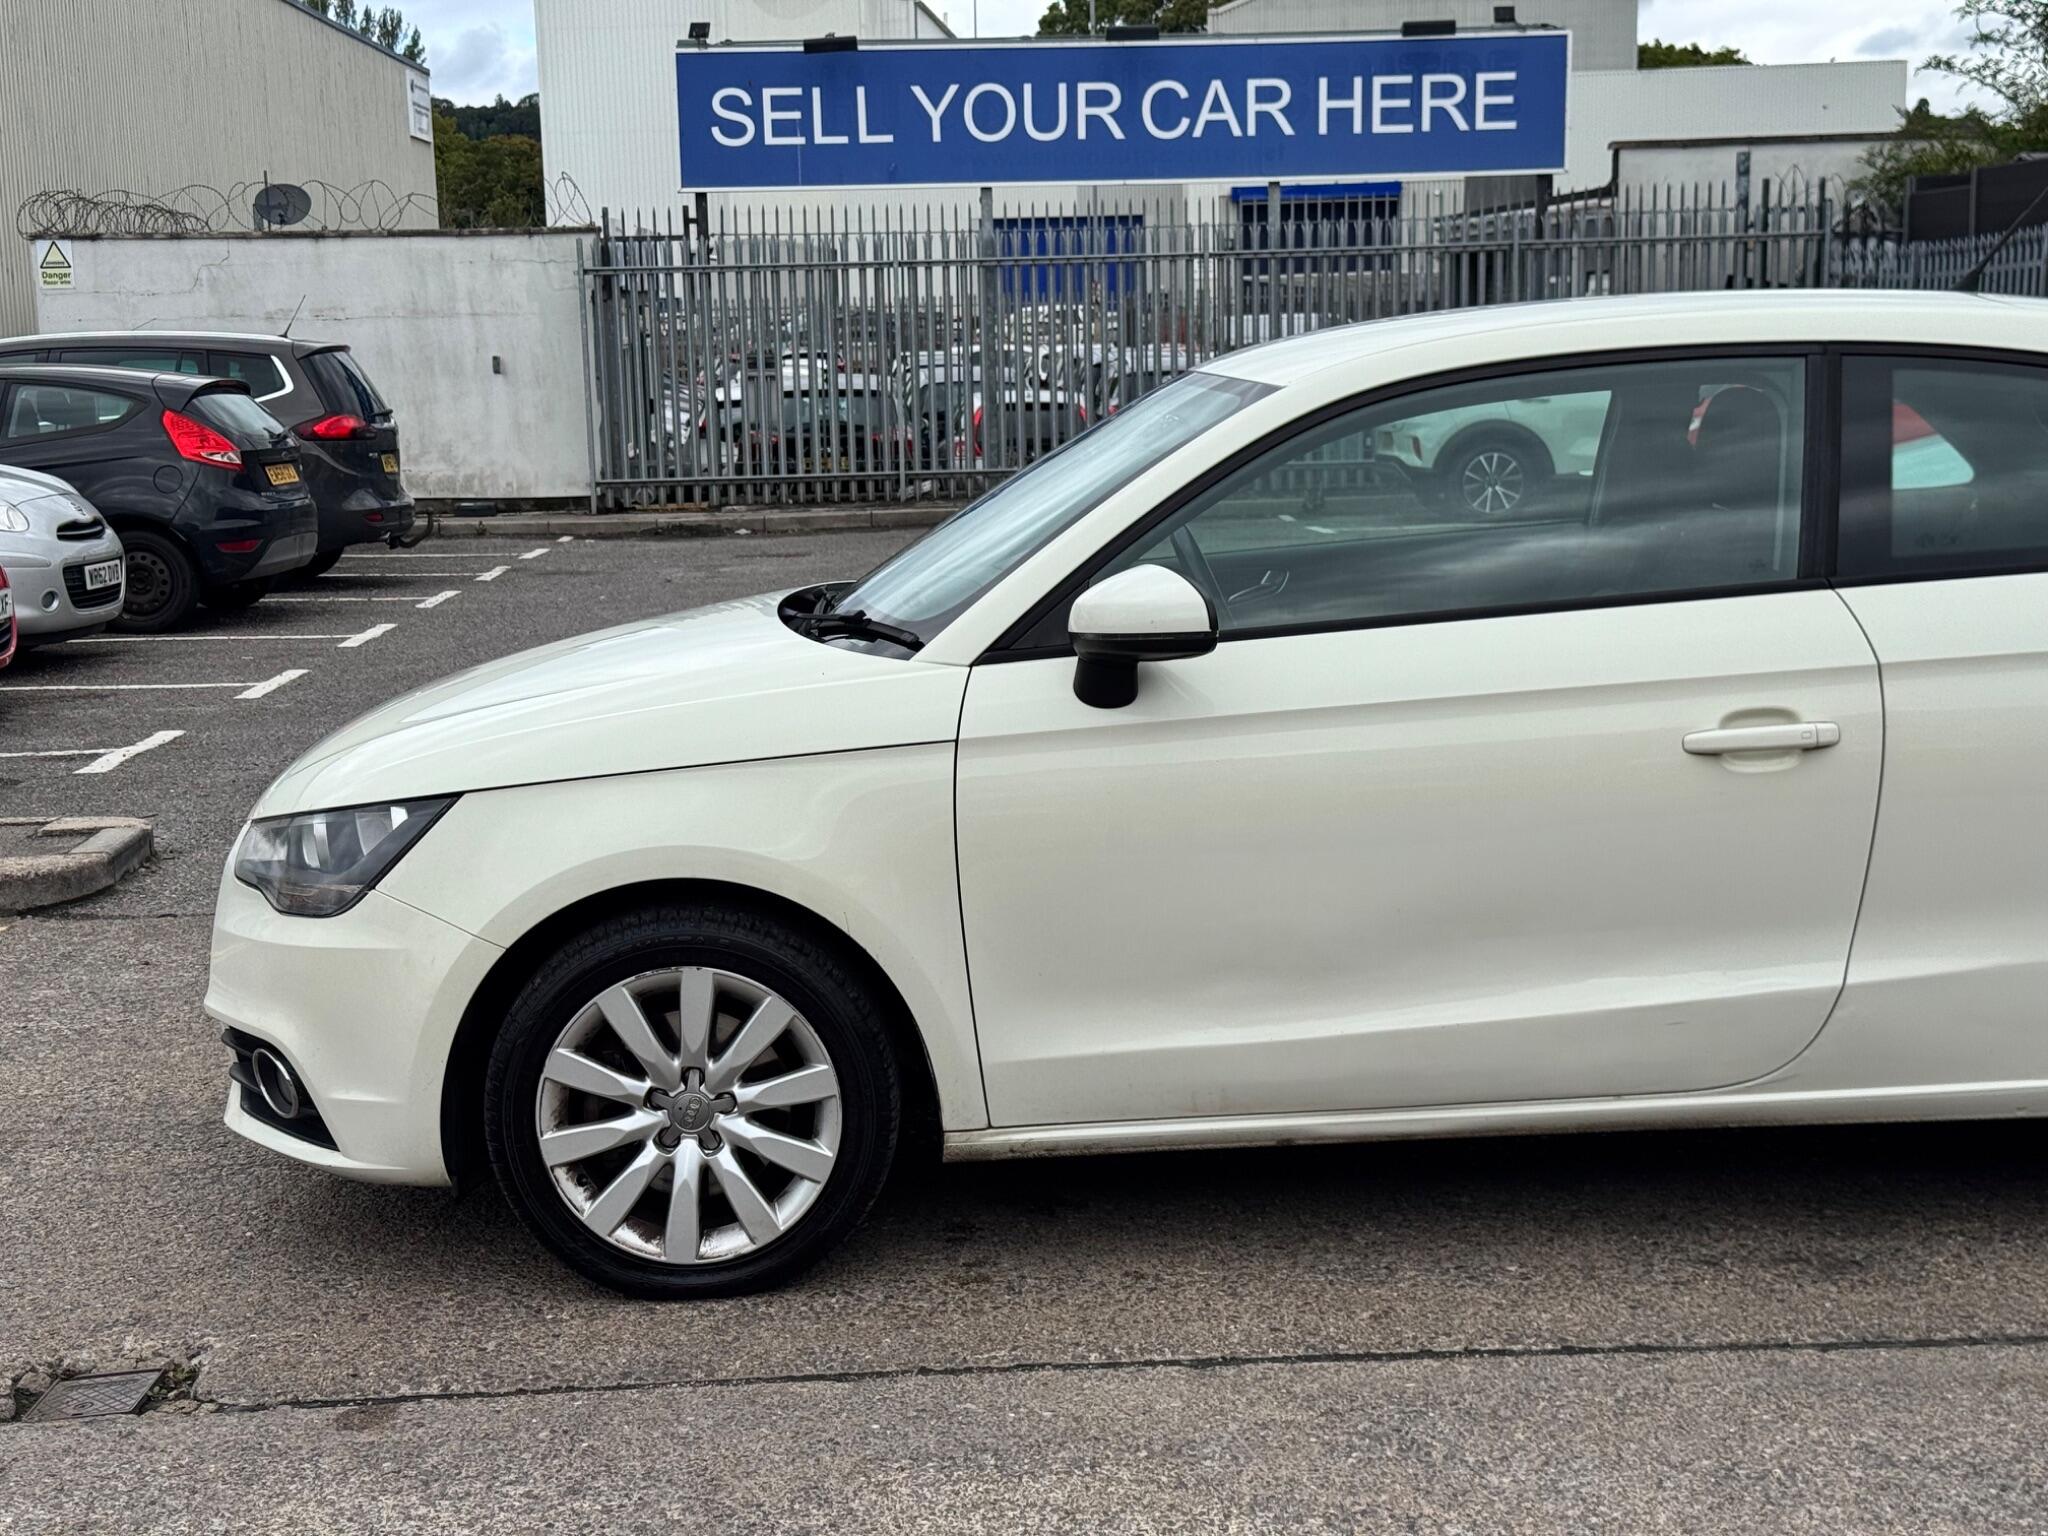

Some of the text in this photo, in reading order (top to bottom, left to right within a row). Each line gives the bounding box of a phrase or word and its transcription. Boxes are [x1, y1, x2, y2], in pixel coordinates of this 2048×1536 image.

[710, 71, 1518, 147] SELL YOUR CAR HERE
[42, 271, 71, 279] Danger
